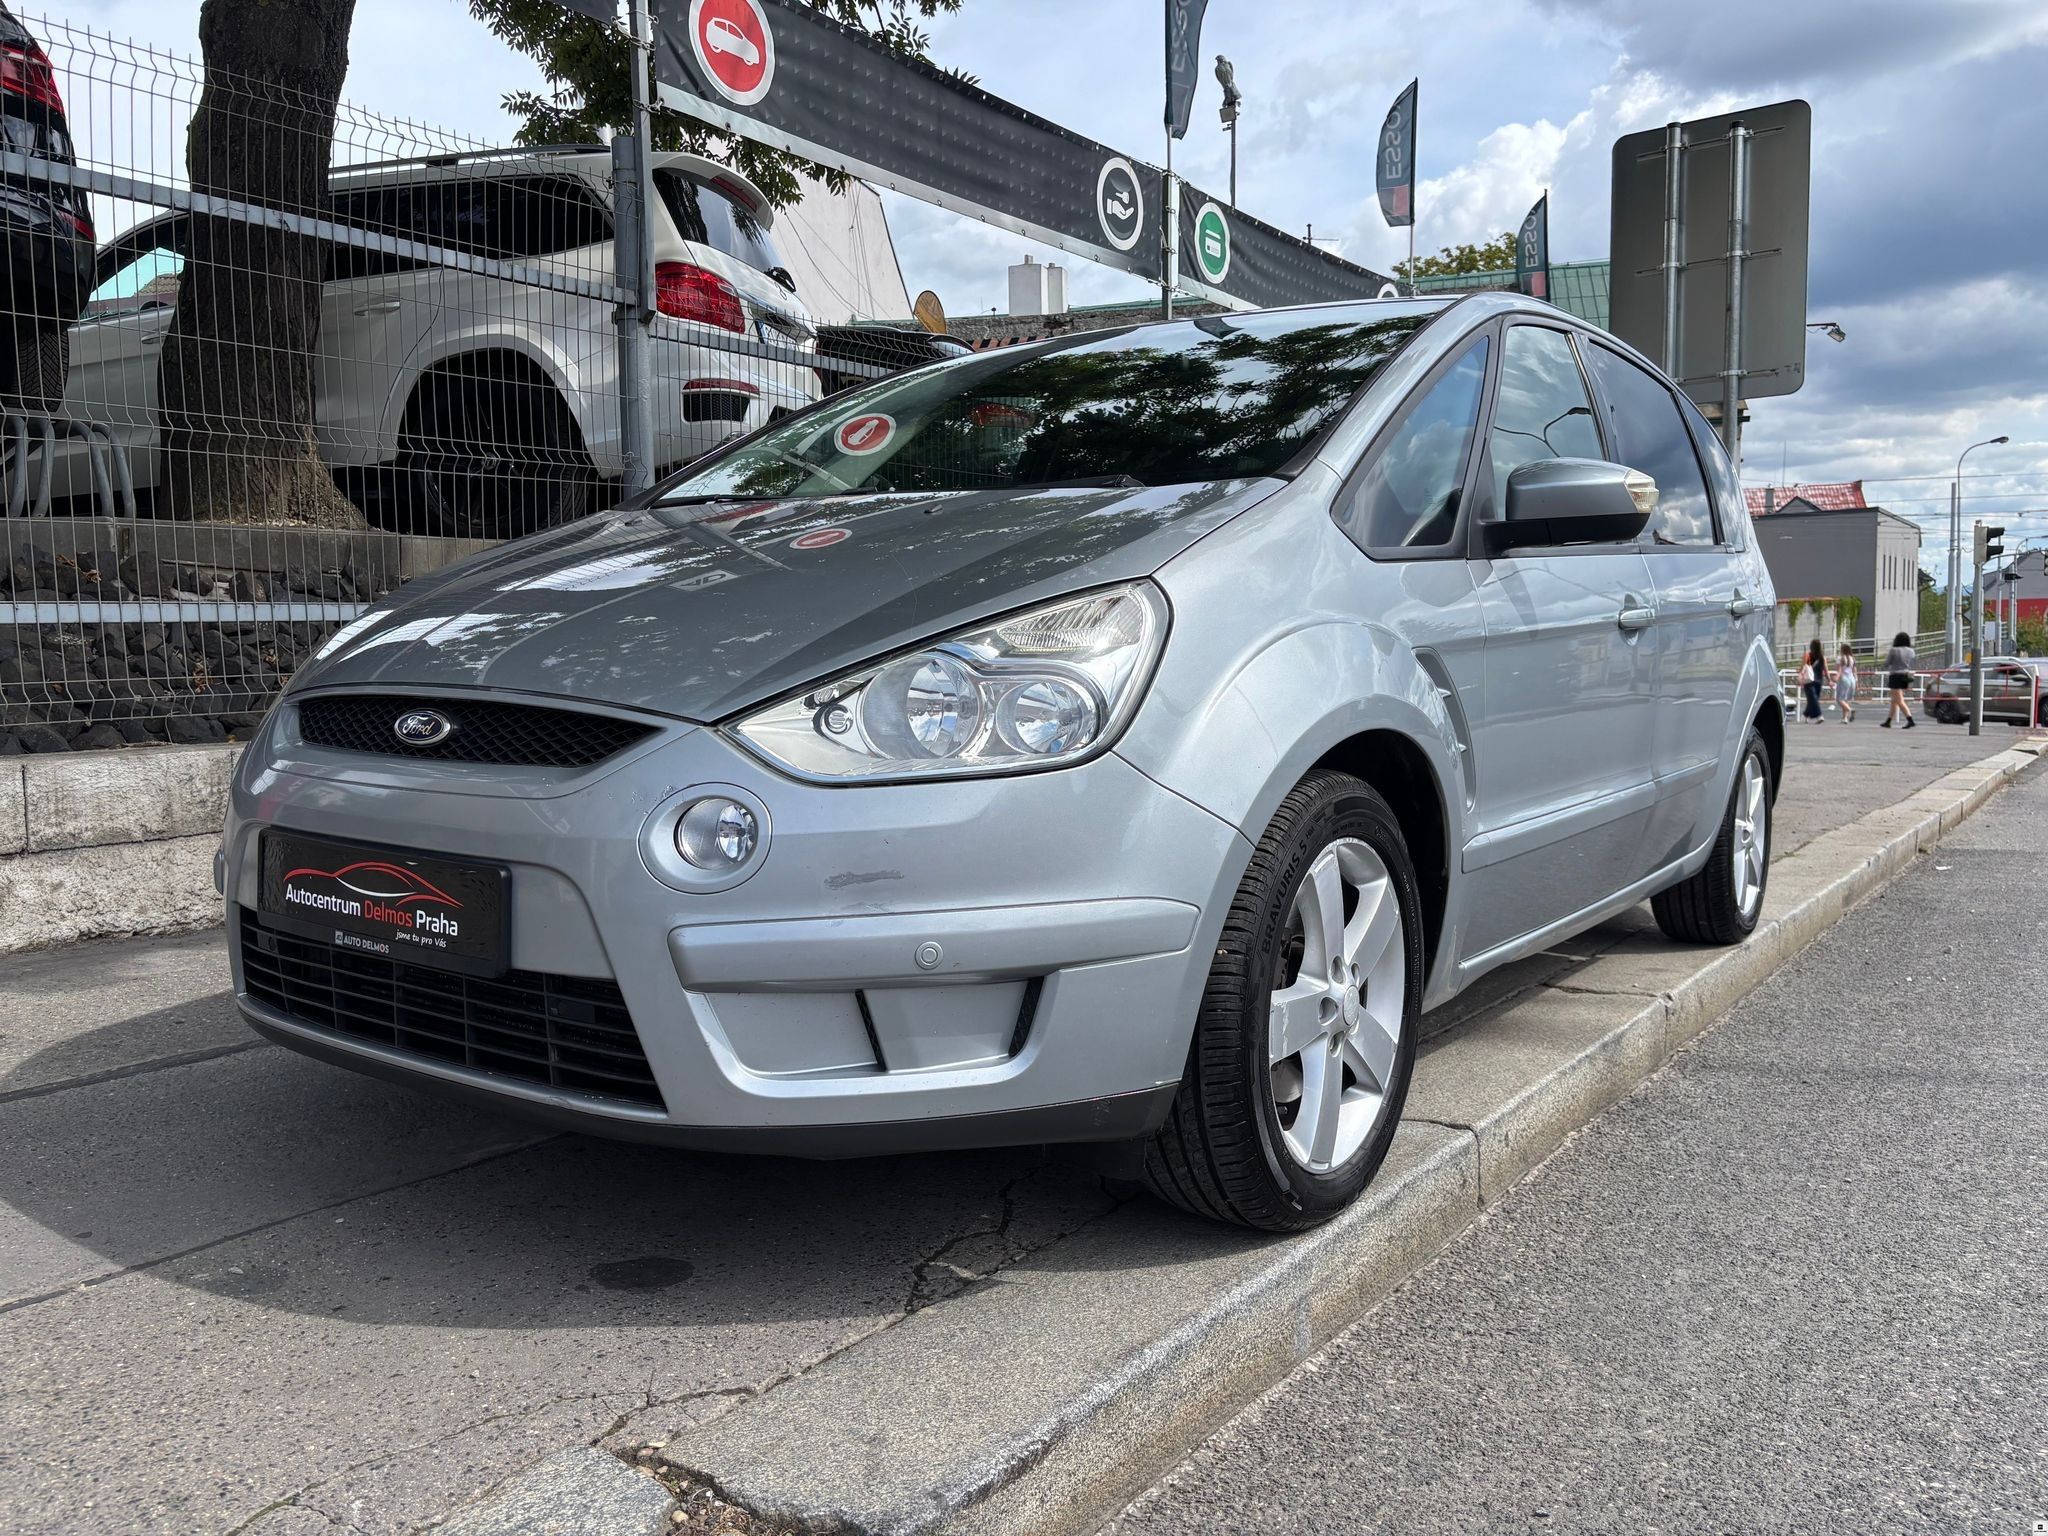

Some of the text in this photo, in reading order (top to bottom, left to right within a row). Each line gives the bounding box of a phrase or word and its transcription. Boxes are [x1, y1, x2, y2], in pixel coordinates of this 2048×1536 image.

[402, 715, 435, 736] Ford
[285, 883, 458, 936] Autocentrum Delmos Praha
[1262, 854, 1300, 954] BRAVURIS
[343, 935, 361, 947] AUTO
[362, 939, 390, 954] DELMOS
[395, 929, 447, 948] jsme tu pro Vás
